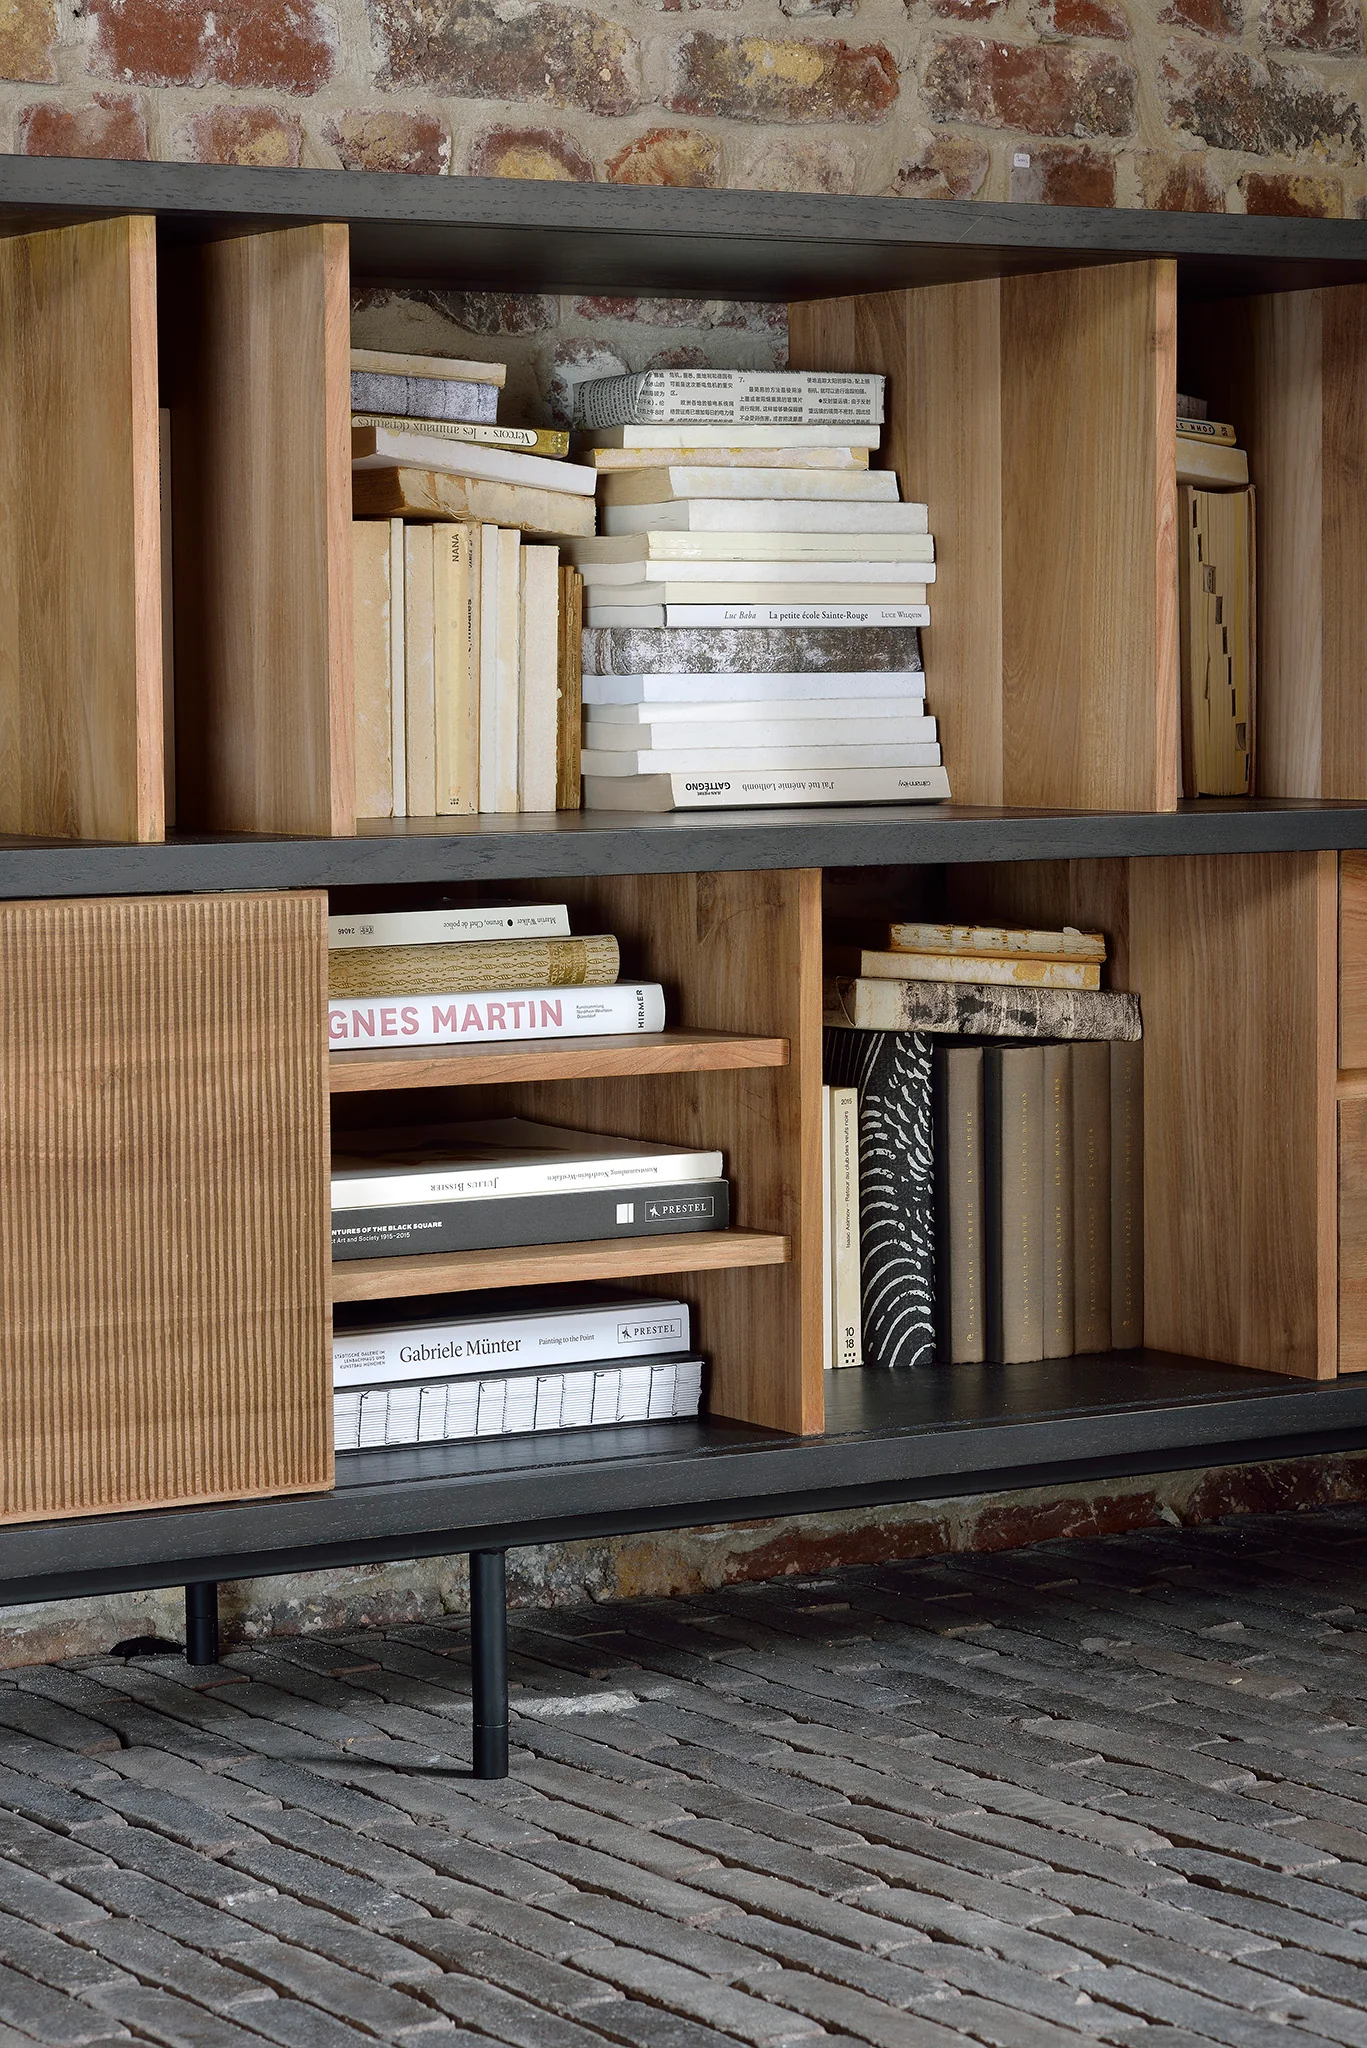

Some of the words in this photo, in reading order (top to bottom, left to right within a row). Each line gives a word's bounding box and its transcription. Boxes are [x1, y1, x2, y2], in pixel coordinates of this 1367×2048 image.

[414, 424, 460, 437] animaux
[1190, 423, 1212, 433] JOHN
[463, 428, 477, 440] les
[493, 429, 531, 444] Vercors
[452, 533, 460, 562] NANA
[724, 611, 738, 619] Luc
[739, 611, 757, 619] Baba
[769, 611, 778, 619] La
[779, 611, 800, 621] petite
[801, 611, 820, 619] école
[821, 611, 869, 621] Sainte-Rouge
[685, 781, 731, 792] GATTÉGNO
[777, 782, 807, 791] Anémie
[807, 782, 821, 791] tué
[443, 920, 461, 930] police
[461, 921, 469, 929] de
[469, 920, 484, 929] Chef
[517, 917, 537, 926] Walker
[537, 916, 557, 925] Martin
[635, 989, 644, 1029] HIRMER
[431, 999, 563, 1034] MARTIN
[610, 1166, 658, 1176] Kunstsammlung
[845, 1171, 850, 1180] au
[430, 1181, 465, 1192] BISSIER
[467, 1176, 499, 1189] JULIUS
[662, 1203, 707, 1214] PRESTEL
[361, 1226, 372, 1234] OF
[372, 1225, 388, 1233] THE
[388, 1223, 413, 1231] BLACK
[413, 1221, 443, 1230] SQUARE
[358, 1234, 379, 1242] Society
[633, 1324, 676, 1336] PRESTEL
[844, 1327, 855, 1337] 10
[538, 1336, 563, 1346] Painting
[569, 1334, 579, 1342] the
[579, 1333, 595, 1342] Point
[844, 1338, 855, 1349] 18
[400, 1341, 463, 1363] Gabriele
[466, 1338, 522, 1357] Münter
